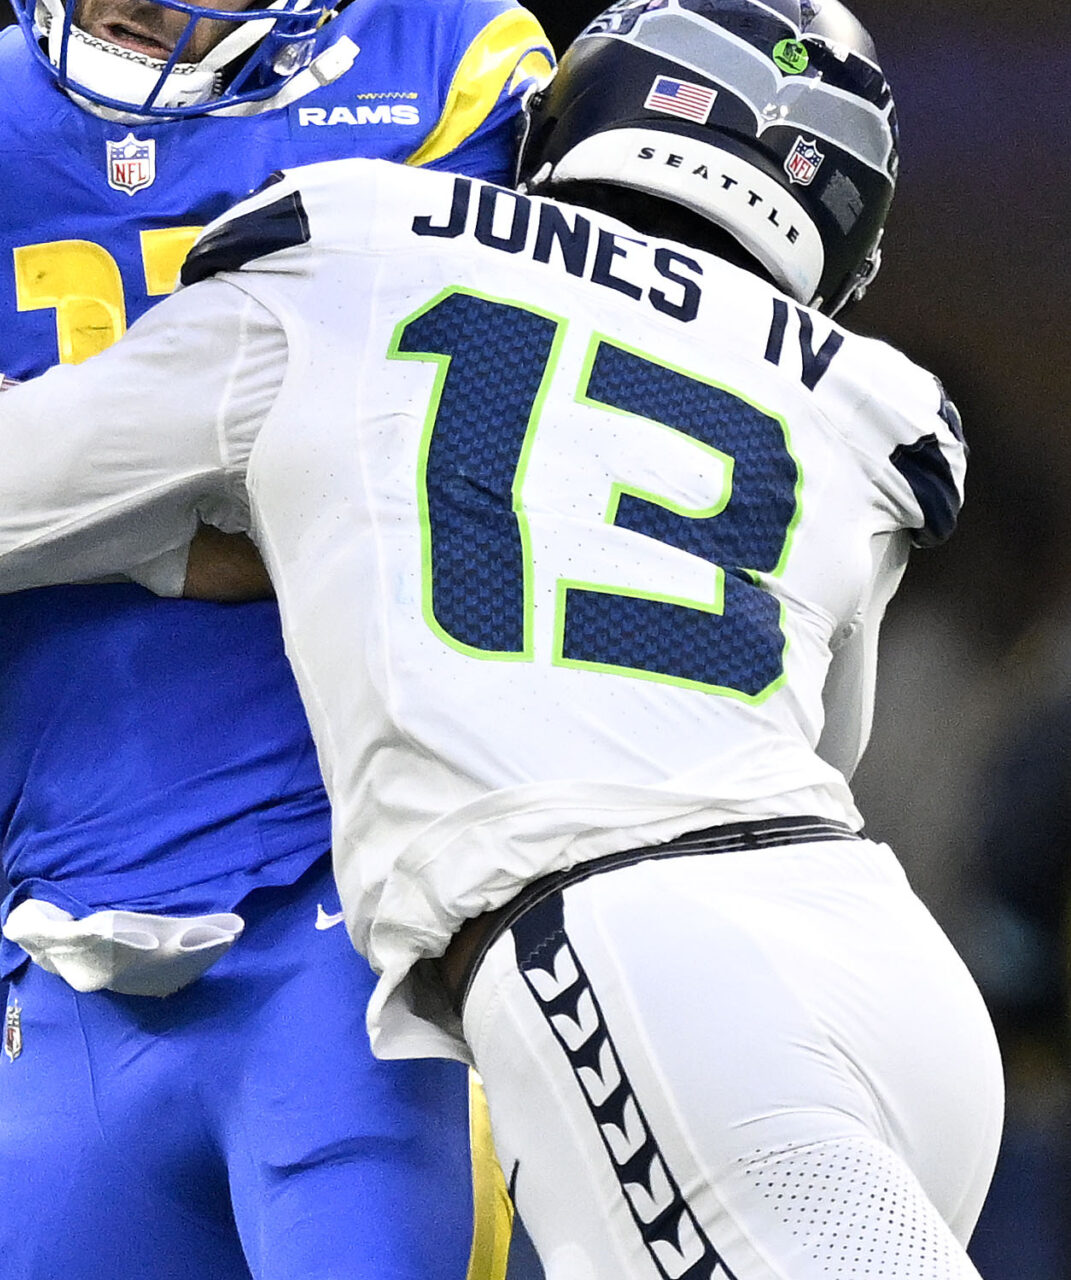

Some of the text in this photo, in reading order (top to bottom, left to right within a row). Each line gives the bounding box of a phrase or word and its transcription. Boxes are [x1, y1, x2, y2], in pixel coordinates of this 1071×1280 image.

[298, 104, 420, 126] RAMS
[115, 162, 147, 185] NFL
[637, 147, 800, 245] SEATTLE
[789, 153, 813, 180] NFL
[411, 178, 845, 392] JONES IV
[387, 284, 804, 705] 13
